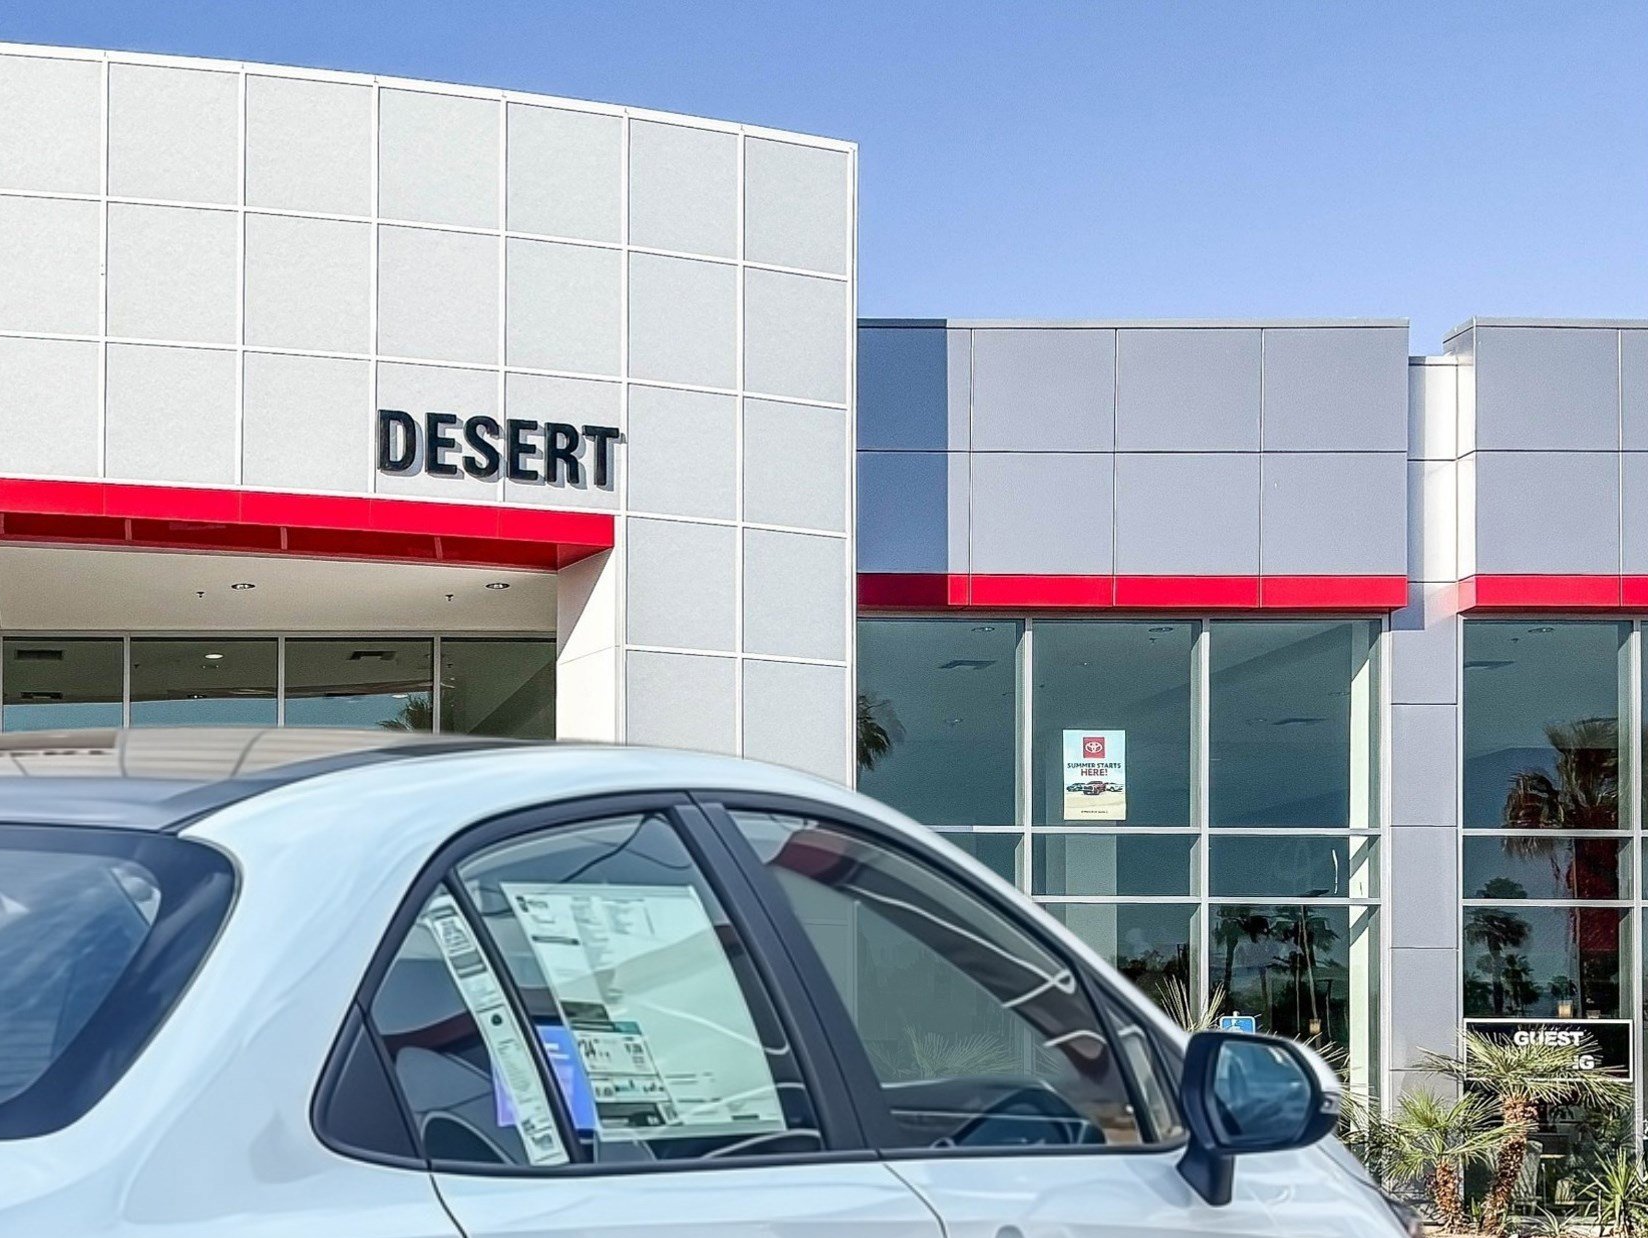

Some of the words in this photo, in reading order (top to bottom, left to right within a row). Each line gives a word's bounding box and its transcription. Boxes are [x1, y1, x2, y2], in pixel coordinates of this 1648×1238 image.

[377, 409, 620, 486] DESERT
[1080, 768, 1108, 777] HERE!
[1513, 1030, 1584, 1047] GUEST
